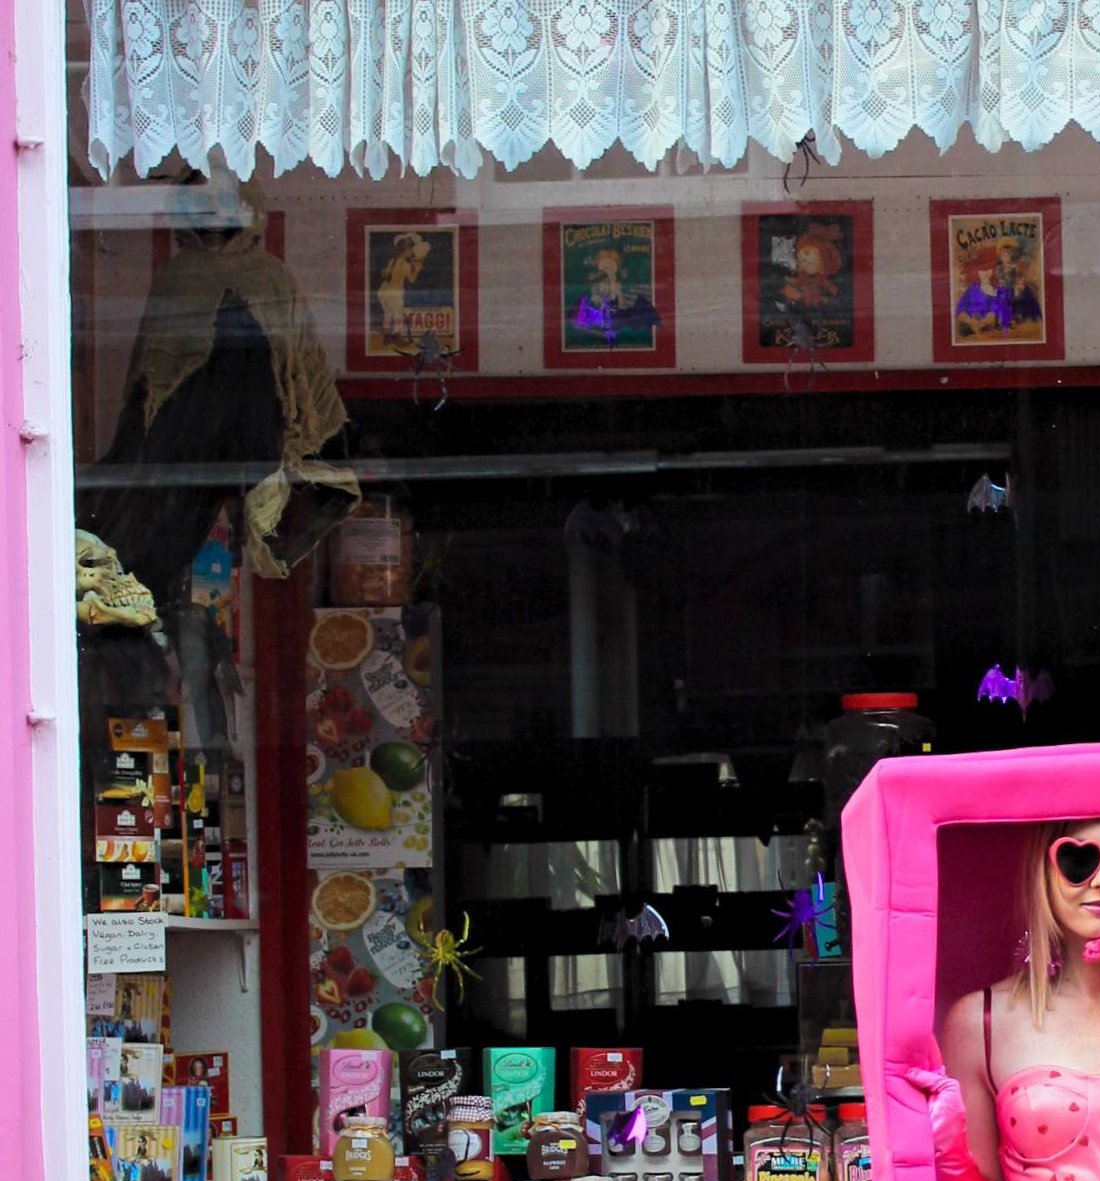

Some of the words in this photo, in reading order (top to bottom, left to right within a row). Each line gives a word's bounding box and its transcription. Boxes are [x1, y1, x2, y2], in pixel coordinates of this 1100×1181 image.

[956, 226, 997, 248] CACAO
[112, 918, 134, 926] also
[138, 916, 165, 926] Stock
[94, 944, 123, 955] Sugar
[94, 955, 115, 966] Free
[120, 953, 165, 965] Products
[417, 1070, 446, 1078] LINDOR
